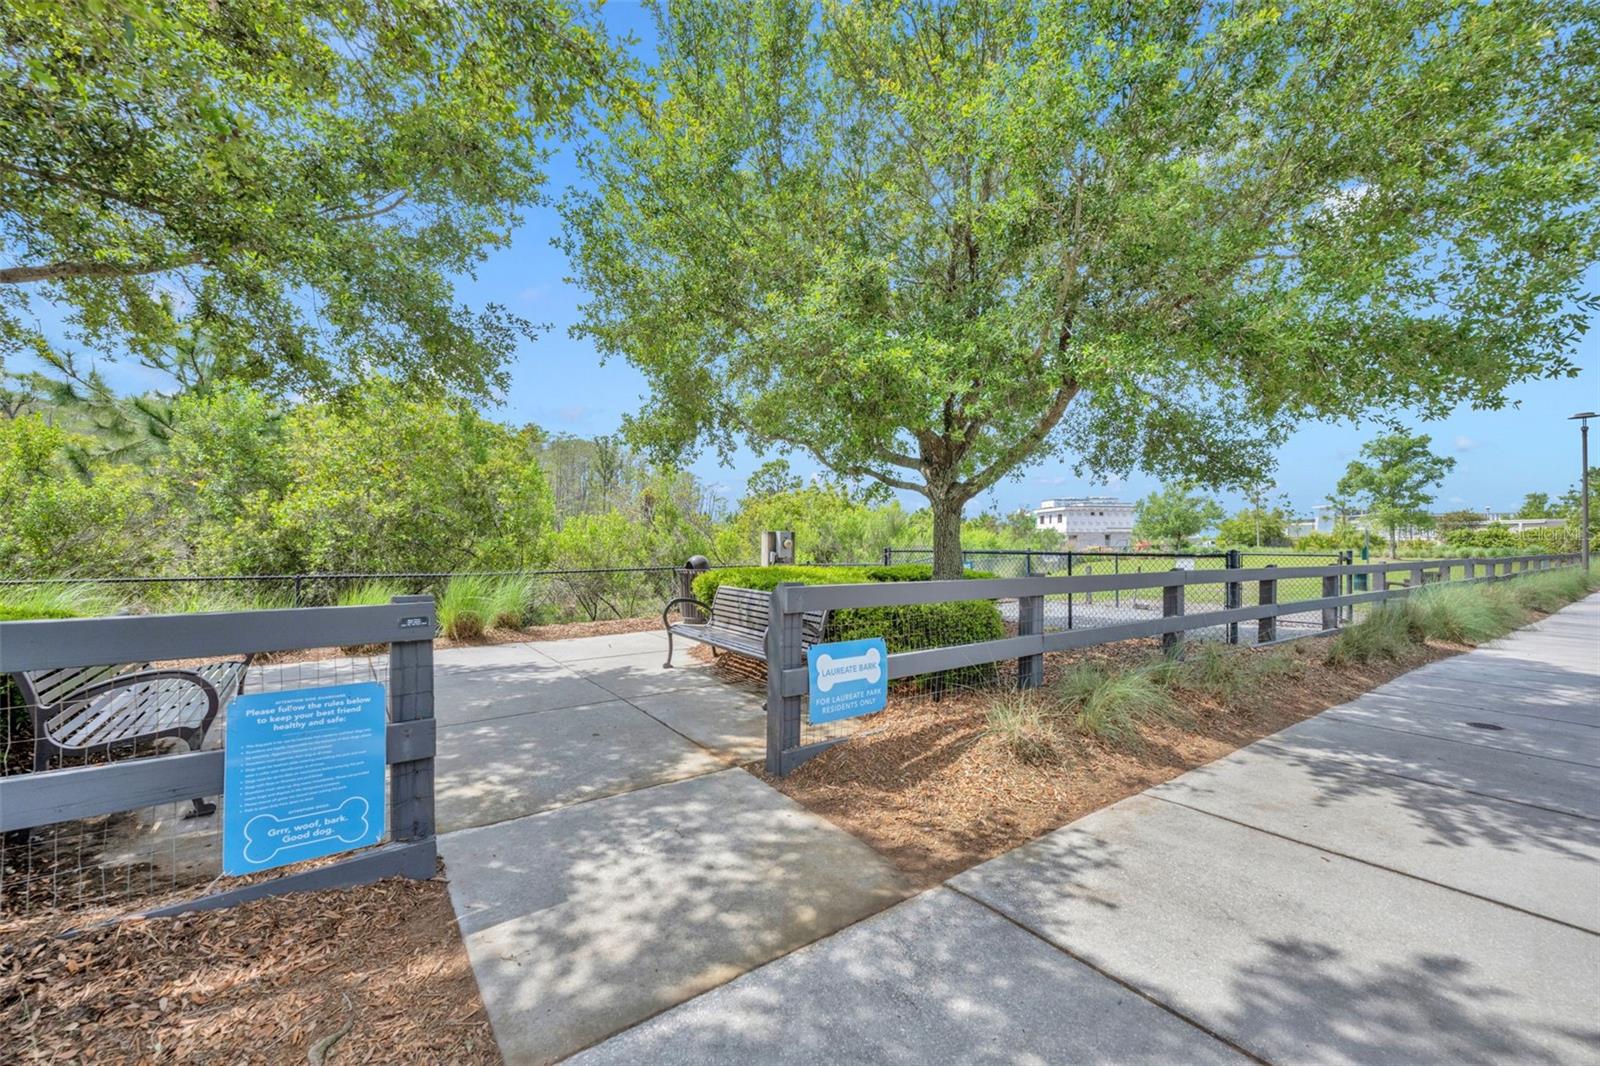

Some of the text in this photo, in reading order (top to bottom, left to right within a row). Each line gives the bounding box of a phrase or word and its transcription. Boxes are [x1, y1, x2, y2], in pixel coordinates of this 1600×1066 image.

[821, 662, 878, 677] LAUREATE BARK
[278, 705, 305, 713] follow
[308, 701, 322, 709] the
[324, 699, 345, 707] rules
[347, 696, 371, 704] below
[816, 688, 881, 706] FOR LAUREATE PARK
[270, 714, 292, 724] keep
[294, 712, 314, 721] your
[337, 704, 361, 713] friend
[822, 701, 858, 713] RESIDENTS
[273, 722, 306, 731] healthy
[308, 718, 325, 726] and
[267, 815, 348, 837] Grrr, woof, bark.
[282, 826, 334, 842] Good dog.
